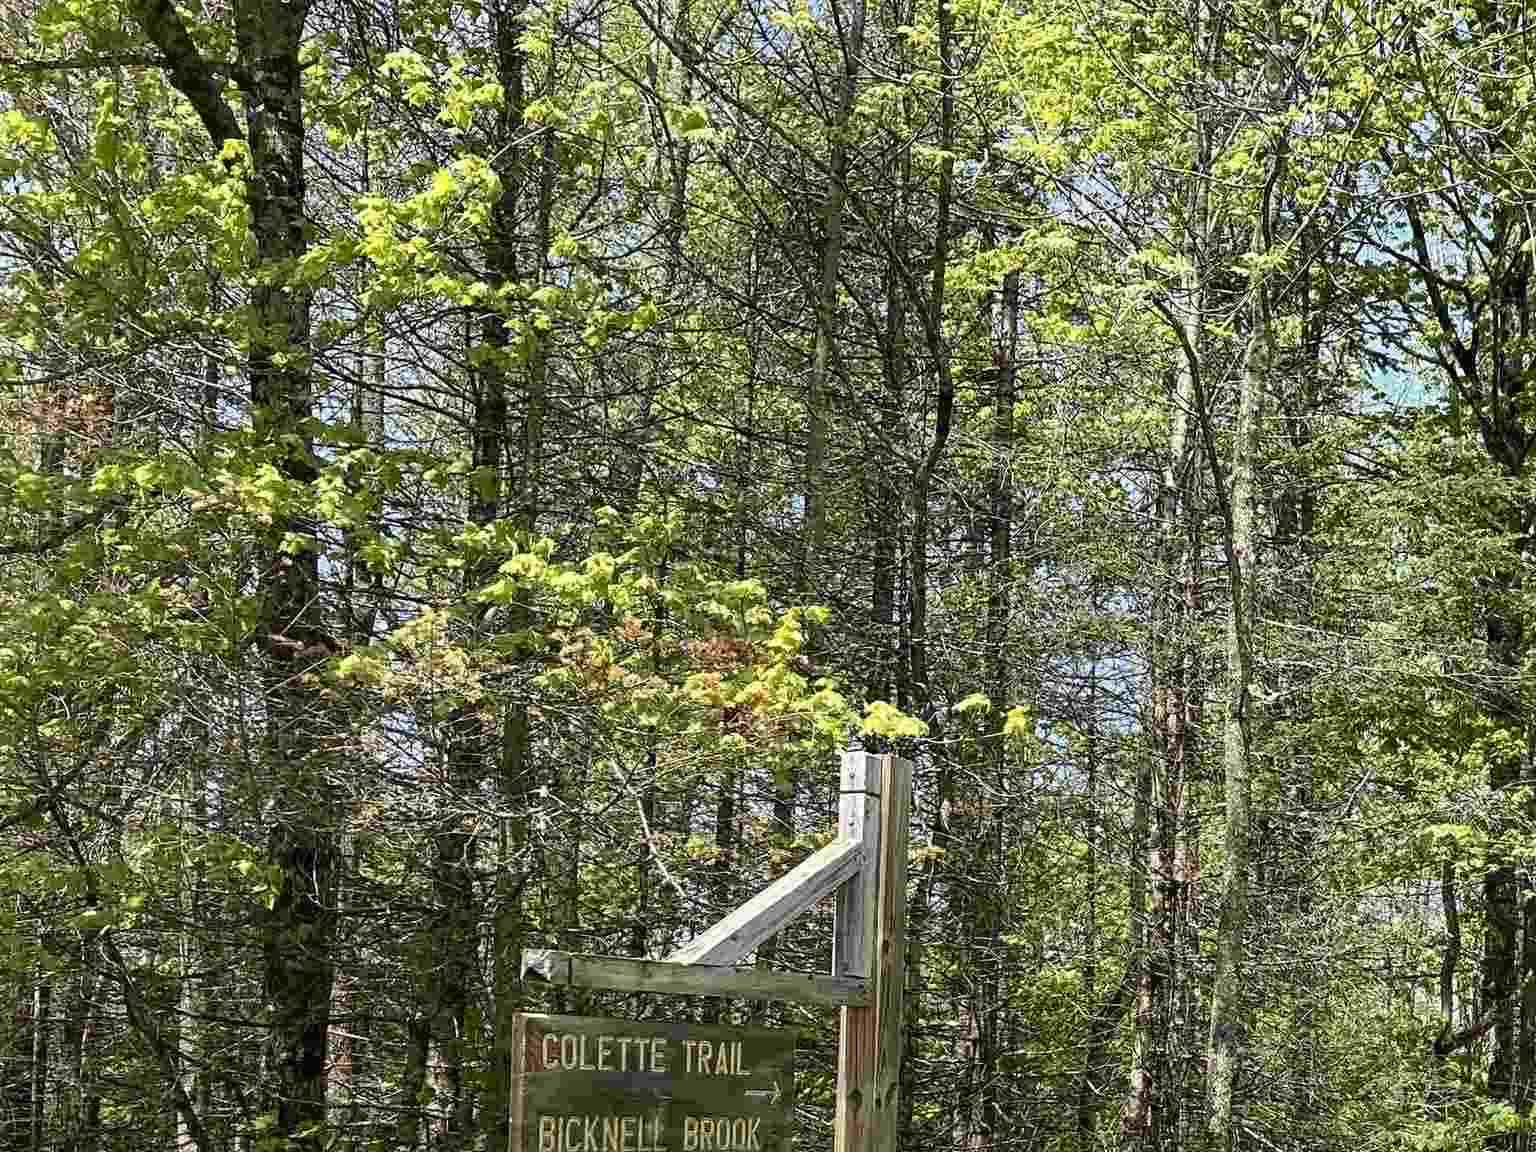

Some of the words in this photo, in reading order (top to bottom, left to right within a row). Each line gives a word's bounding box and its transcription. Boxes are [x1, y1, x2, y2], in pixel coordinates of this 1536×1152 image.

[541, 1033, 668, 1073] COLETTE
[683, 1040, 752, 1076] TRAIL
[537, 1114, 669, 1152] BICKNELL
[682, 1114, 763, 1152] BROOK
